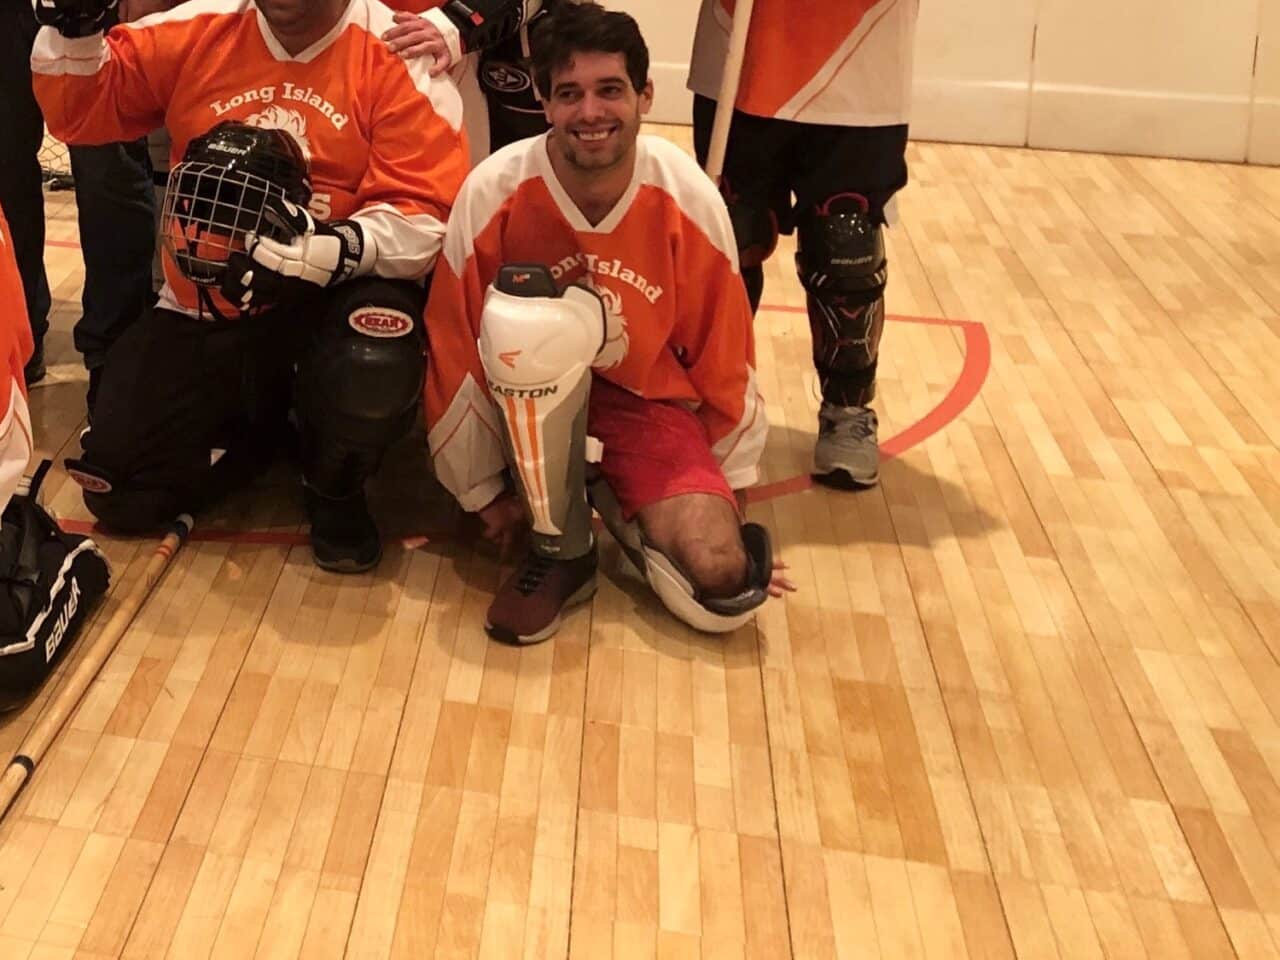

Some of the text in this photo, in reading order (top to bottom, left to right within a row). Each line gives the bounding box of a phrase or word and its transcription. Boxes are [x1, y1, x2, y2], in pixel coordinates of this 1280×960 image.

[210, 82, 349, 130] Long Island
[585, 254, 663, 304] Island
[45, 576, 80, 663] BAUER
